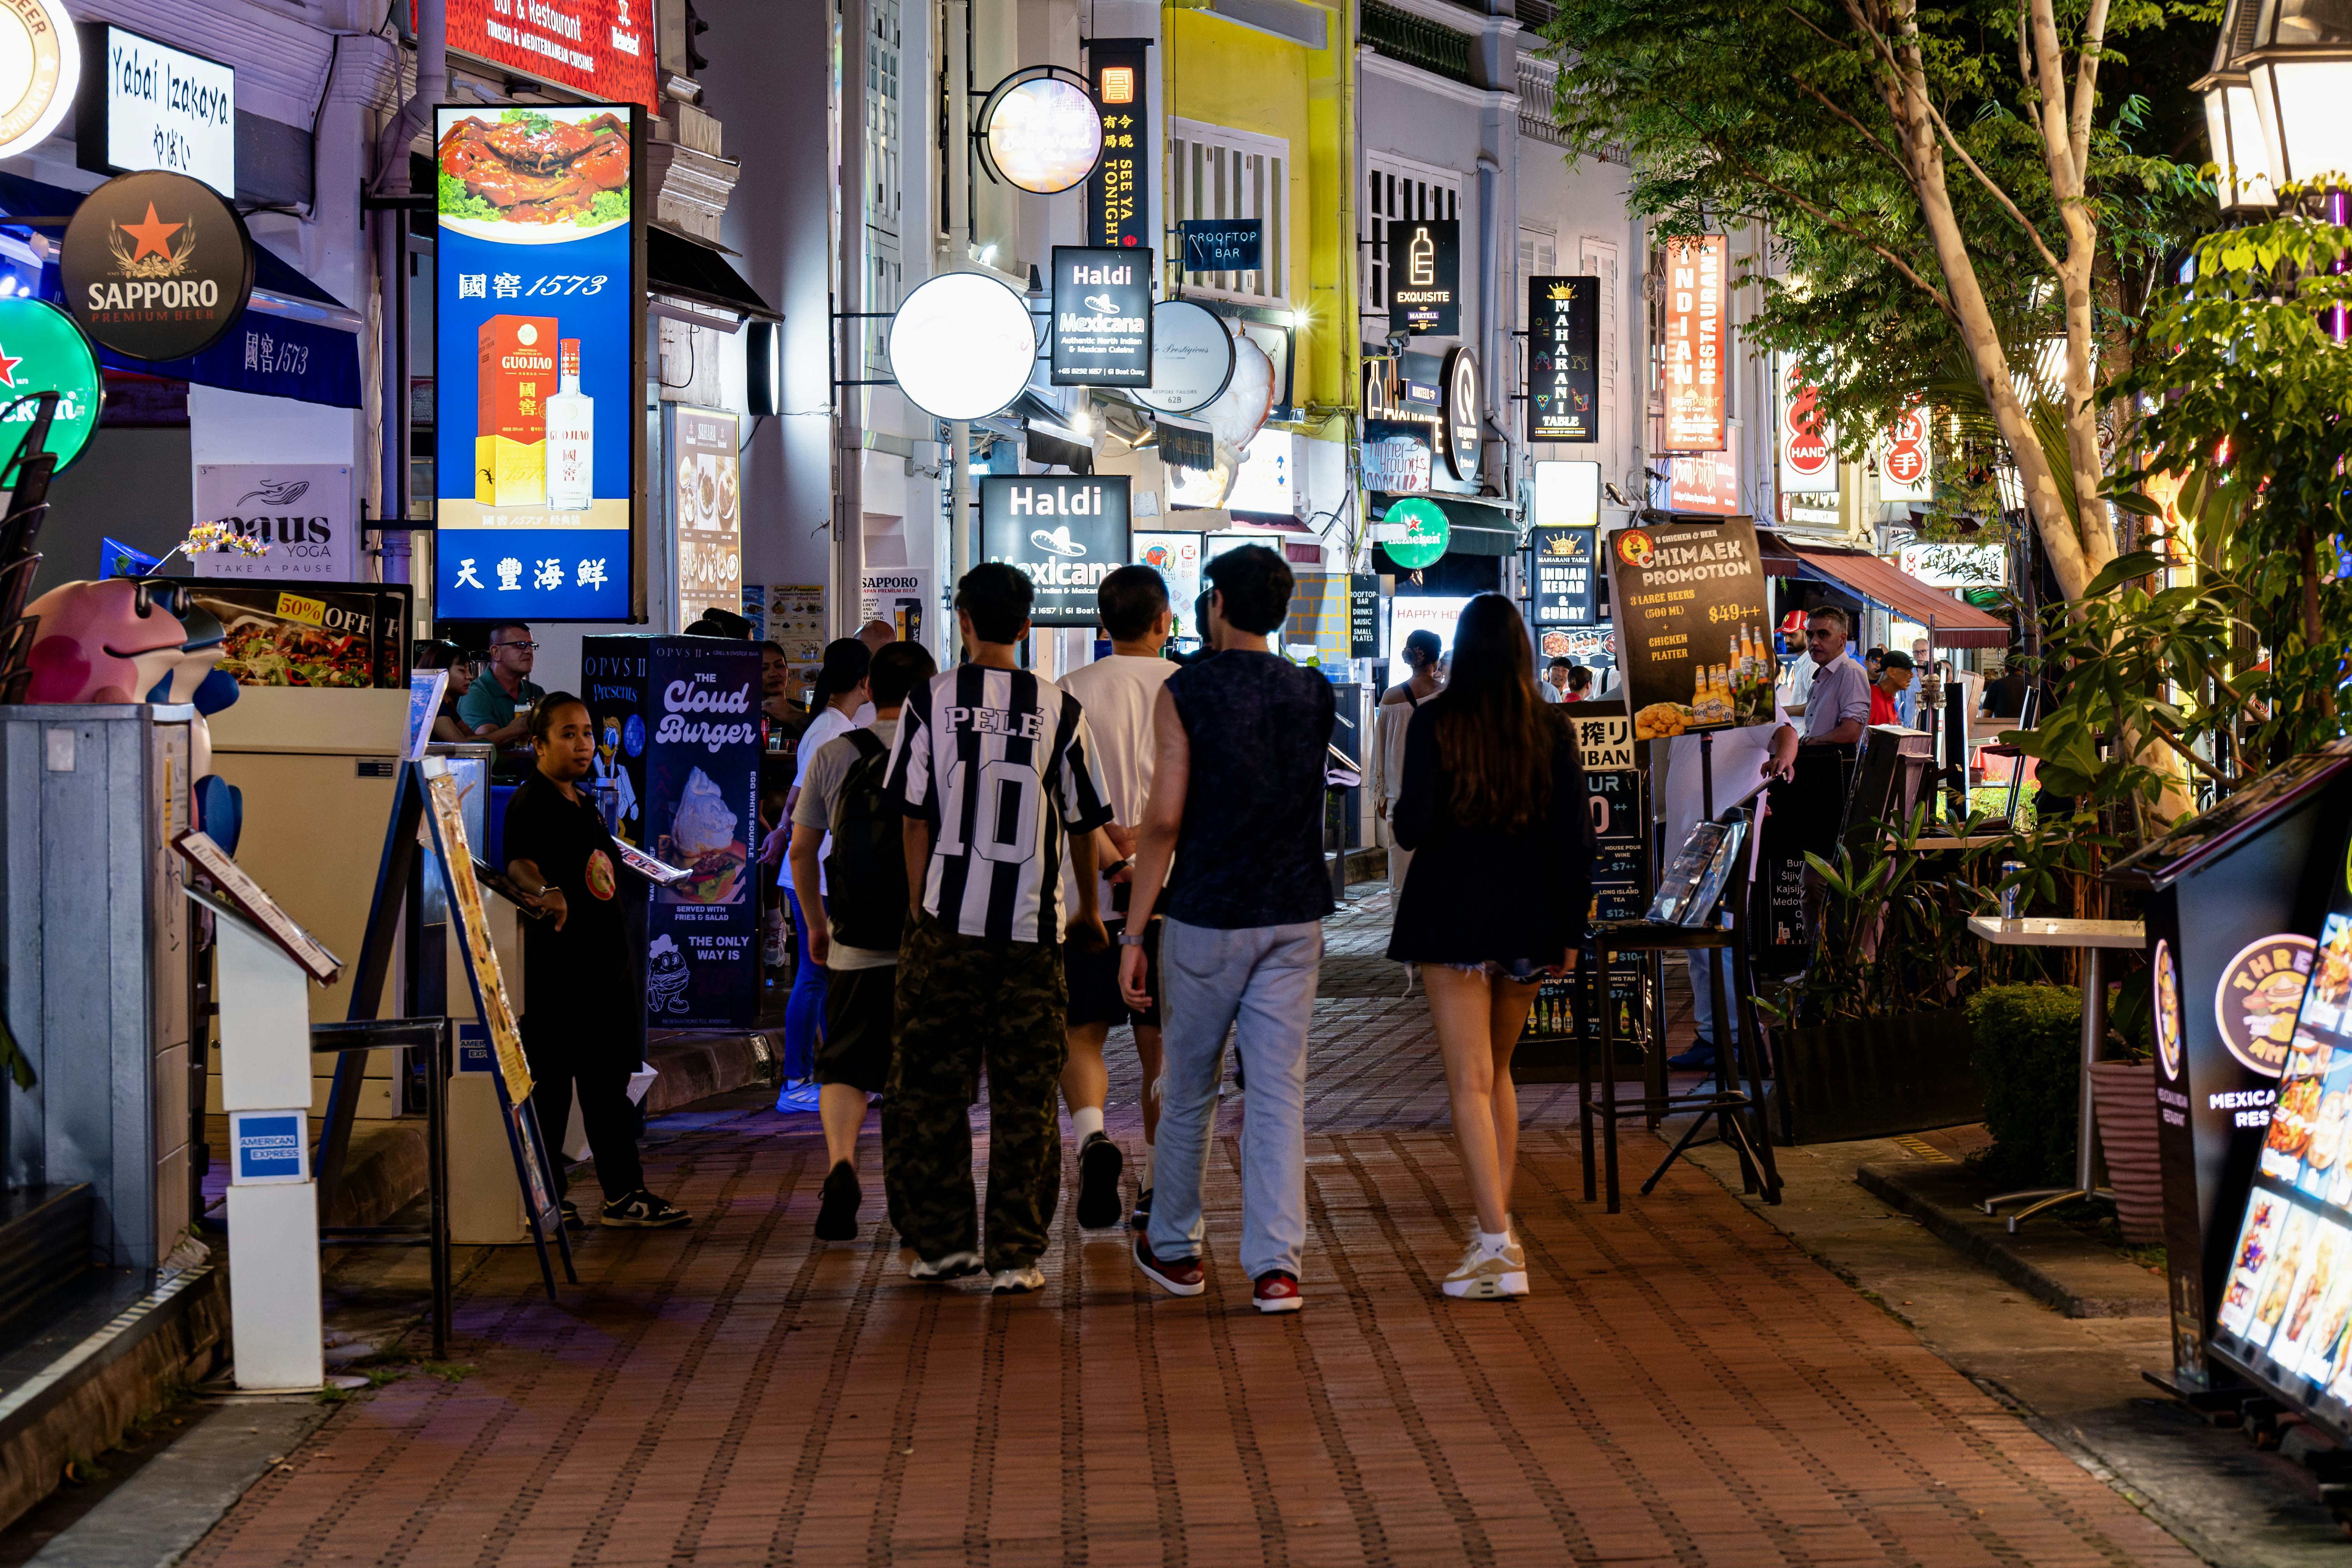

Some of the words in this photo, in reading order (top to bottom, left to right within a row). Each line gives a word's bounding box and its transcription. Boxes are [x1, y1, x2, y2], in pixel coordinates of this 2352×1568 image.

[529, 0, 582, 42] Restaurant
[487, 19, 512, 44] TURKISH
[514, 27, 519, 46] &
[521, 32, 569, 64] MEDITERRANEAN
[570, 50, 594, 72] CUISINE
[113, 46, 158, 104] Yabai
[168, 63, 228, 128] Izakaya
[153, 124, 191, 171] やばい
[1105, 159, 1118, 247] TONIGHT
[1198, 232, 1256, 242] ROOFTOP
[1216, 248, 1239, 257] BAR
[1073, 266, 1131, 285] Haldi
[89, 280, 218, 310] SAPPORO
[1397, 291, 1449, 303] EXQUISITE
[92, 312, 168, 323] PREMIUM
[175, 310, 214, 321] BEER
[1699, 243, 1717, 384] RESTAURANT
[1059, 312, 1144, 333] Mexicana
[1061, 336, 1096, 345] Authentic
[1097, 337, 1118, 345] North
[1120, 337, 1142, 345] Indian
[502, 356, 552, 369] GUOJIAO
[1555, 299, 1569, 414] MAHARANI
[1412, 385, 1430, 399] MARTELL
[1542, 416, 1579, 427] TABLE
[698, 423, 716, 441] SAHARA
[1698, 435, 1715, 443] Quay
[1791, 447, 1826, 458] HAND
[1010, 485, 1101, 516] Haldi
[1662, 533, 1692, 543] CHICKEN
[1700, 530, 1718, 538] BEER
[287, 545, 331, 557] YOGA
[1183, 546, 1195, 558] 62
[1637, 541, 1744, 569] CHIMAEK
[1540, 568, 1587, 581] INDIAN
[1643, 560, 1752, 586] PROMOTION
[1542, 581, 1585, 593] KEBAB
[1558, 596, 1568, 606] &
[1630, 596, 1637, 606] 3
[1638, 593, 1666, 605] LARGE
[1667, 589, 1696, 601] BEERS
[279, 597, 321, 621] 50%
[325, 607, 371, 635] OFF
[1397, 609, 1438, 619] HAPPY
[1442, 610, 1461, 619] HO
[1540, 607, 1586, 620] CURRY
[1645, 608, 1667, 619] (500
[1669, 606, 1684, 617] ML)
[1709, 603, 1761, 624] $49++
[1648, 634, 1688, 647] CHICKEN
[1651, 649, 1688, 661] PLATTER
[695, 673, 717, 683] THE
[593, 683, 638, 702] Presents
[663, 680, 749, 714] Cloud
[945, 707, 1045, 742] PELÉ
[655, 714, 756, 753] Burger
[1580, 721, 1628, 747] 搾り
[1580, 749, 1630, 766] IBAN
[1588, 776, 1619, 792] UR
[933, 760, 1042, 864] 10
[1612, 862, 1636, 871] $7++
[1606, 908, 1635, 917] $12++
[688, 936, 713, 947] THE
[716, 936, 750, 947] ONLY
[697, 950, 723, 960] WAY
[728, 950, 740, 960] IS
[2233, 949, 2314, 991] THRE
[1538, 987, 1565, 996] $5++
[460, 1040, 486, 1048] AMER
[2209, 1090, 2277, 1110] MEXICA
[240, 1136, 294, 1146] AMERICAN
[251, 1149, 299, 1159] EXPRESS
